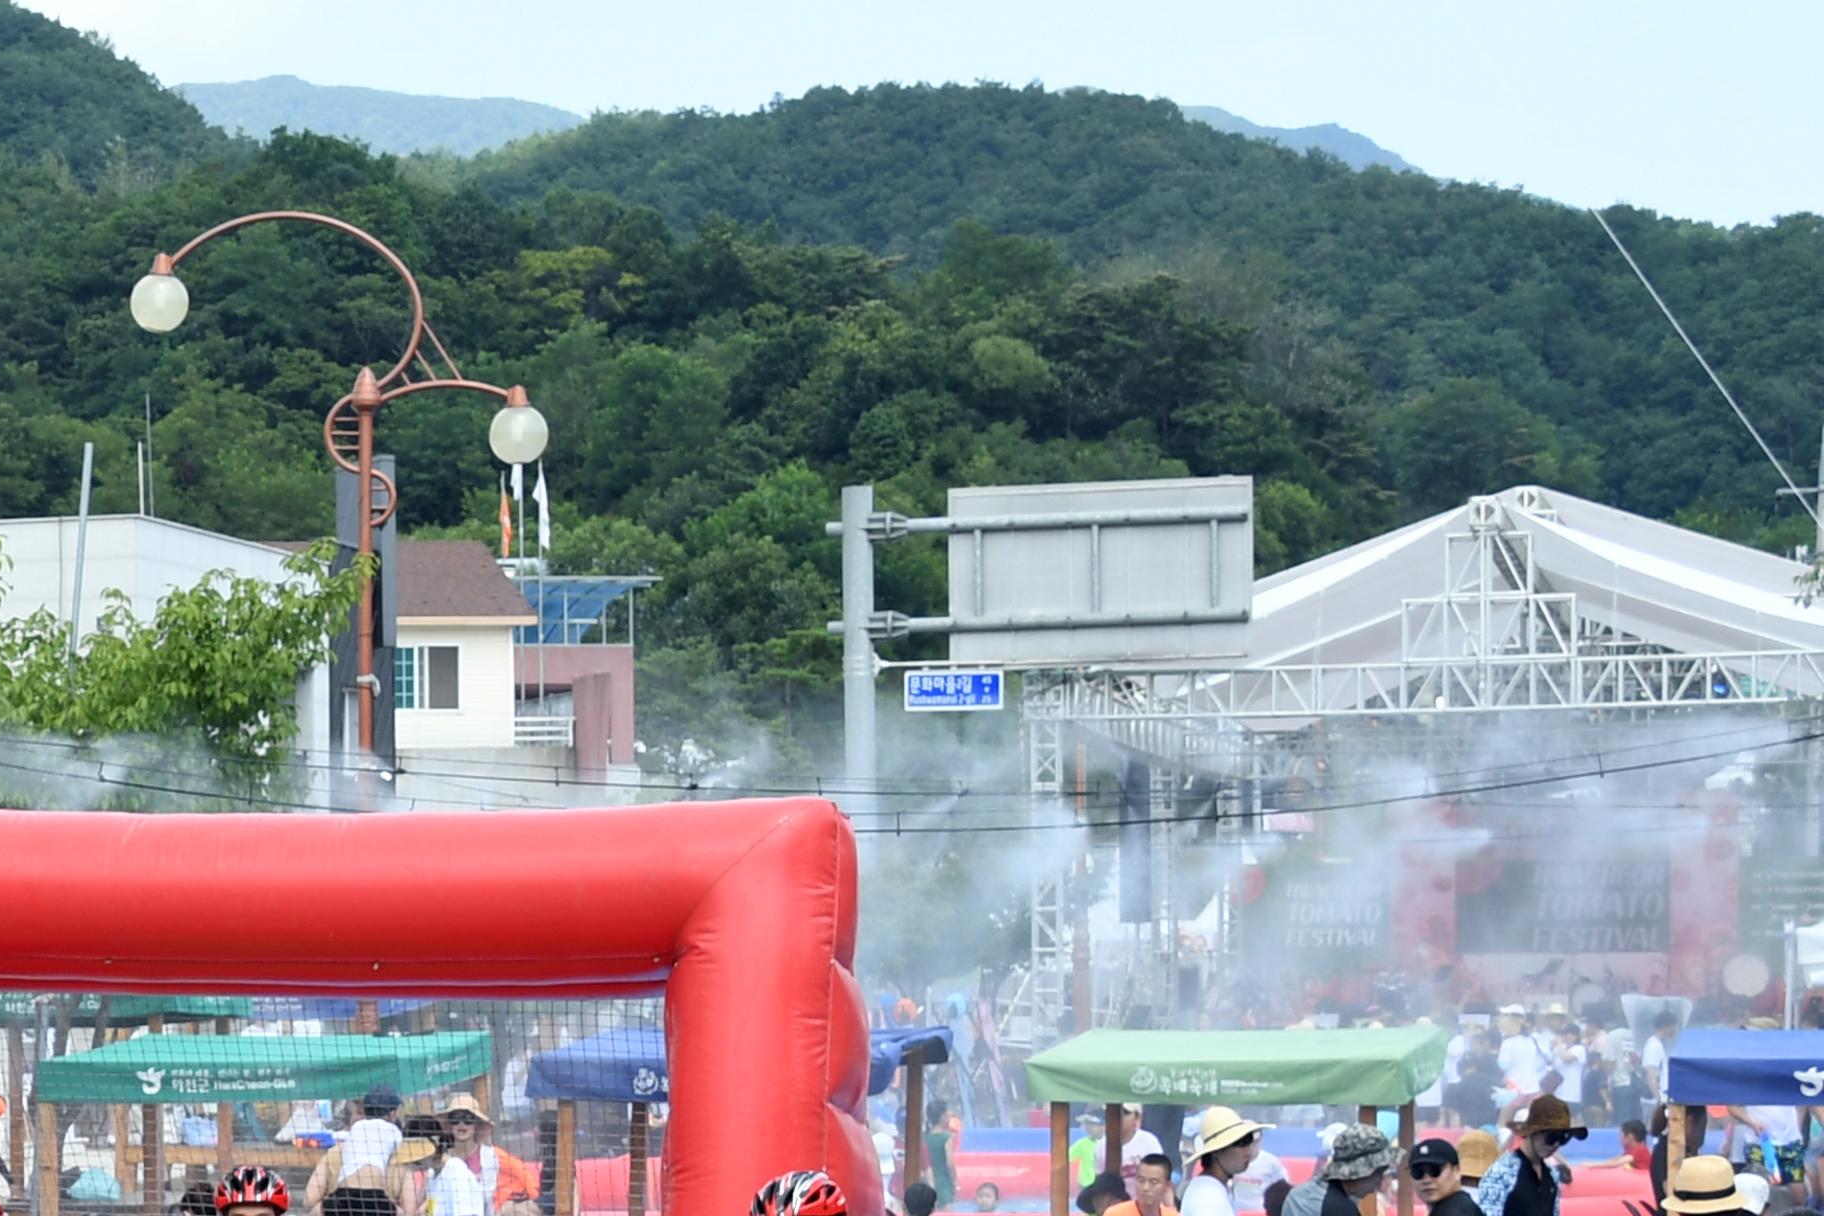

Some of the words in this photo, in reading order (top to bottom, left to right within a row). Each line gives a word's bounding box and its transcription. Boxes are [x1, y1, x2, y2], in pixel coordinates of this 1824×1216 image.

[1533, 890, 1666, 920] TOMATO
[1284, 927, 1379, 949] FESTIVAL
[1531, 926, 1660, 951] FESTIVAL
